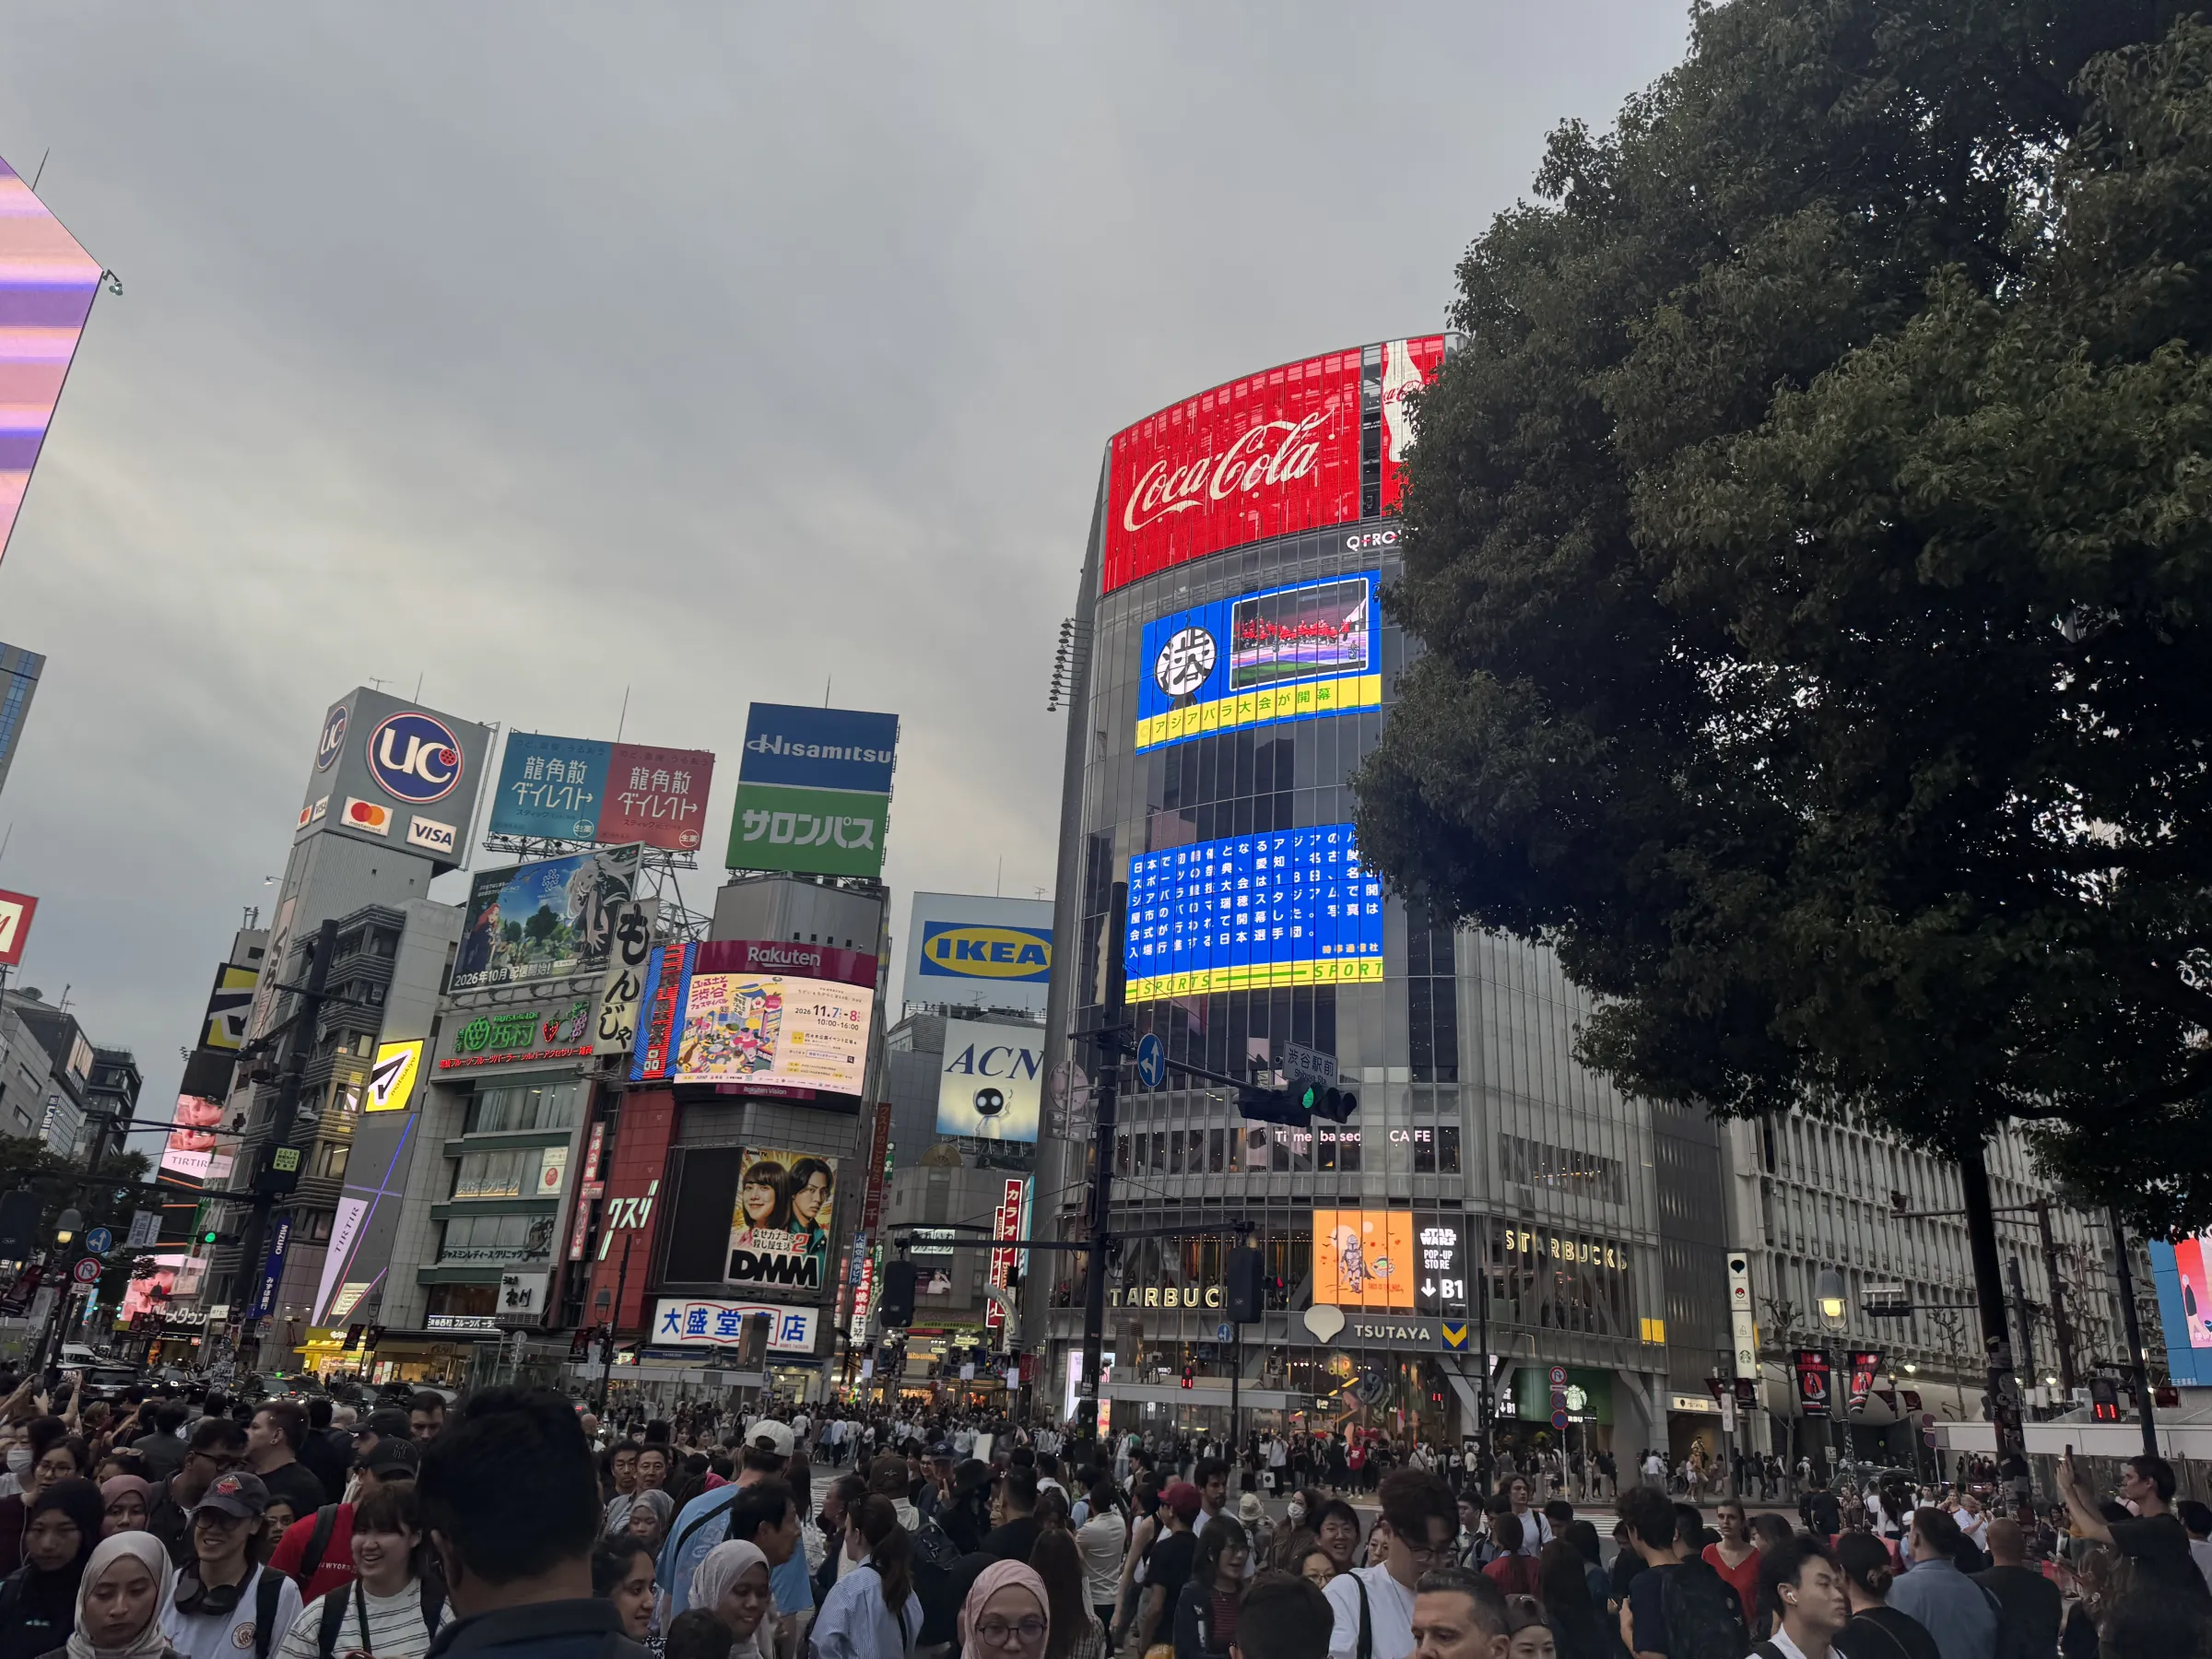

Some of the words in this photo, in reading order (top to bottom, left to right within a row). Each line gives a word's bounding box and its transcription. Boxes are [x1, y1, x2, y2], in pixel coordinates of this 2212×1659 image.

[1124, 405, 1335, 532] Coca-Cola
[747, 734, 891, 763] Hisamitsu
[524, 756, 587, 784] 龍角散
[629, 766, 691, 794] 龍角散
[413, 822, 453, 846] VISA
[742, 809, 875, 851] サロンパス
[747, 947, 821, 967] Rakuten
[936, 938, 1048, 966] IKEA
[454, 968, 508, 987] 2026年10月
[1144, 975, 1210, 994] SPORTS
[489, 1021, 536, 1049] 西村
[1288, 1048, 1334, 1077] 渋谷駅前
[768, 1087, 787, 1096] Vision
[1275, 1130, 1312, 1143] Time
[1320, 1129, 1361, 1143] based
[1389, 1130, 1431, 1143] CAFE
[171, 1156, 208, 1168] TIRTIR
[276, 1224, 288, 1255] MIZUHO
[334, 1206, 361, 1254] TIRTIR
[753, 1229, 794, 1241] 幸せカナコの
[1422, 1228, 1455, 1237] STAR
[753, 1240, 791, 1252] 殺し屋生活
[1420, 1236, 1456, 1246] WARS
[1424, 1250, 1453, 1260] POP-UP
[1425, 1260, 1450, 1270] STORE
[727, 1250, 818, 1287] DMM
[1110, 1288, 1228, 1307] TARBUC
[1441, 1278, 1465, 1300] B1
[661, 1308, 807, 1342] 大盛堂店
[1354, 1324, 1430, 1341] TSUTAYA
[1507, 1403, 1516, 1414] B1
